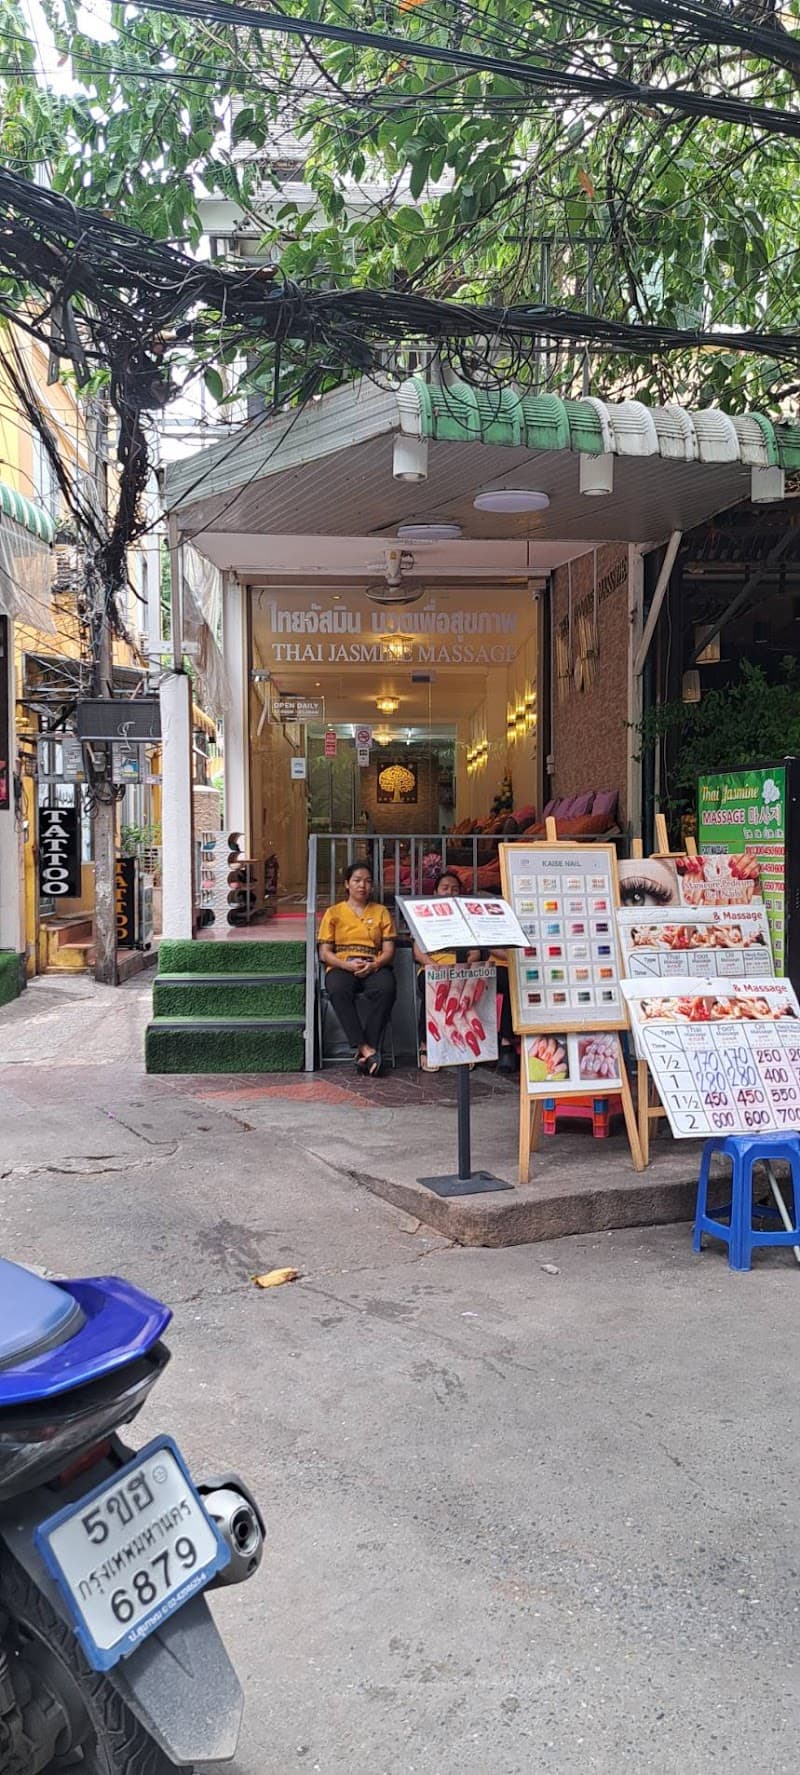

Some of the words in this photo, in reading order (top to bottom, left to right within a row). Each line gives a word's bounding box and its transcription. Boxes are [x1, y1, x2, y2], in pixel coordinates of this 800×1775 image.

[269, 601, 361, 633] ไทยจัสมิน
[272, 643, 324, 662] THAI
[327, 642, 412, 663] JASMINE
[418, 643, 517, 663] MASSAGE
[702, 785, 720, 801] Thai
[721, 783, 760, 804] Jasmine
[702, 808, 745, 825] MASSAGE
[41, 810, 71, 895] TATTOO
[713, 911, 721, 921] &
[723, 911, 763, 922] Massage
[427, 968, 446, 980] Nail
[449, 967, 496, 979] Extraction
[732, 984, 740, 993] &
[744, 984, 789, 995] Massage
[660, 1029, 675, 1037] Type
[693, 1051, 719, 1073] 170
[723, 1046, 748, 1068] 170
[757, 1048, 782, 1064] 250
[669, 1074, 680, 1089] 1
[696, 1071, 727, 1093] 280
[727, 1065, 757, 1087] 280
[764, 1067, 789, 1083] 400
[671, 1094, 681, 1109] 1
[704, 1092, 729, 1108] 450
[737, 1089, 765, 1107] 450
[771, 1087, 797, 1103] 550
[685, 1114, 699, 1129] 2
[712, 1111, 735, 1129] 600
[744, 1110, 770, 1127] 600
[78, 1498, 193, 1602] กรุงเทพมหานคร
[110, 1536, 198, 1624] 6879
